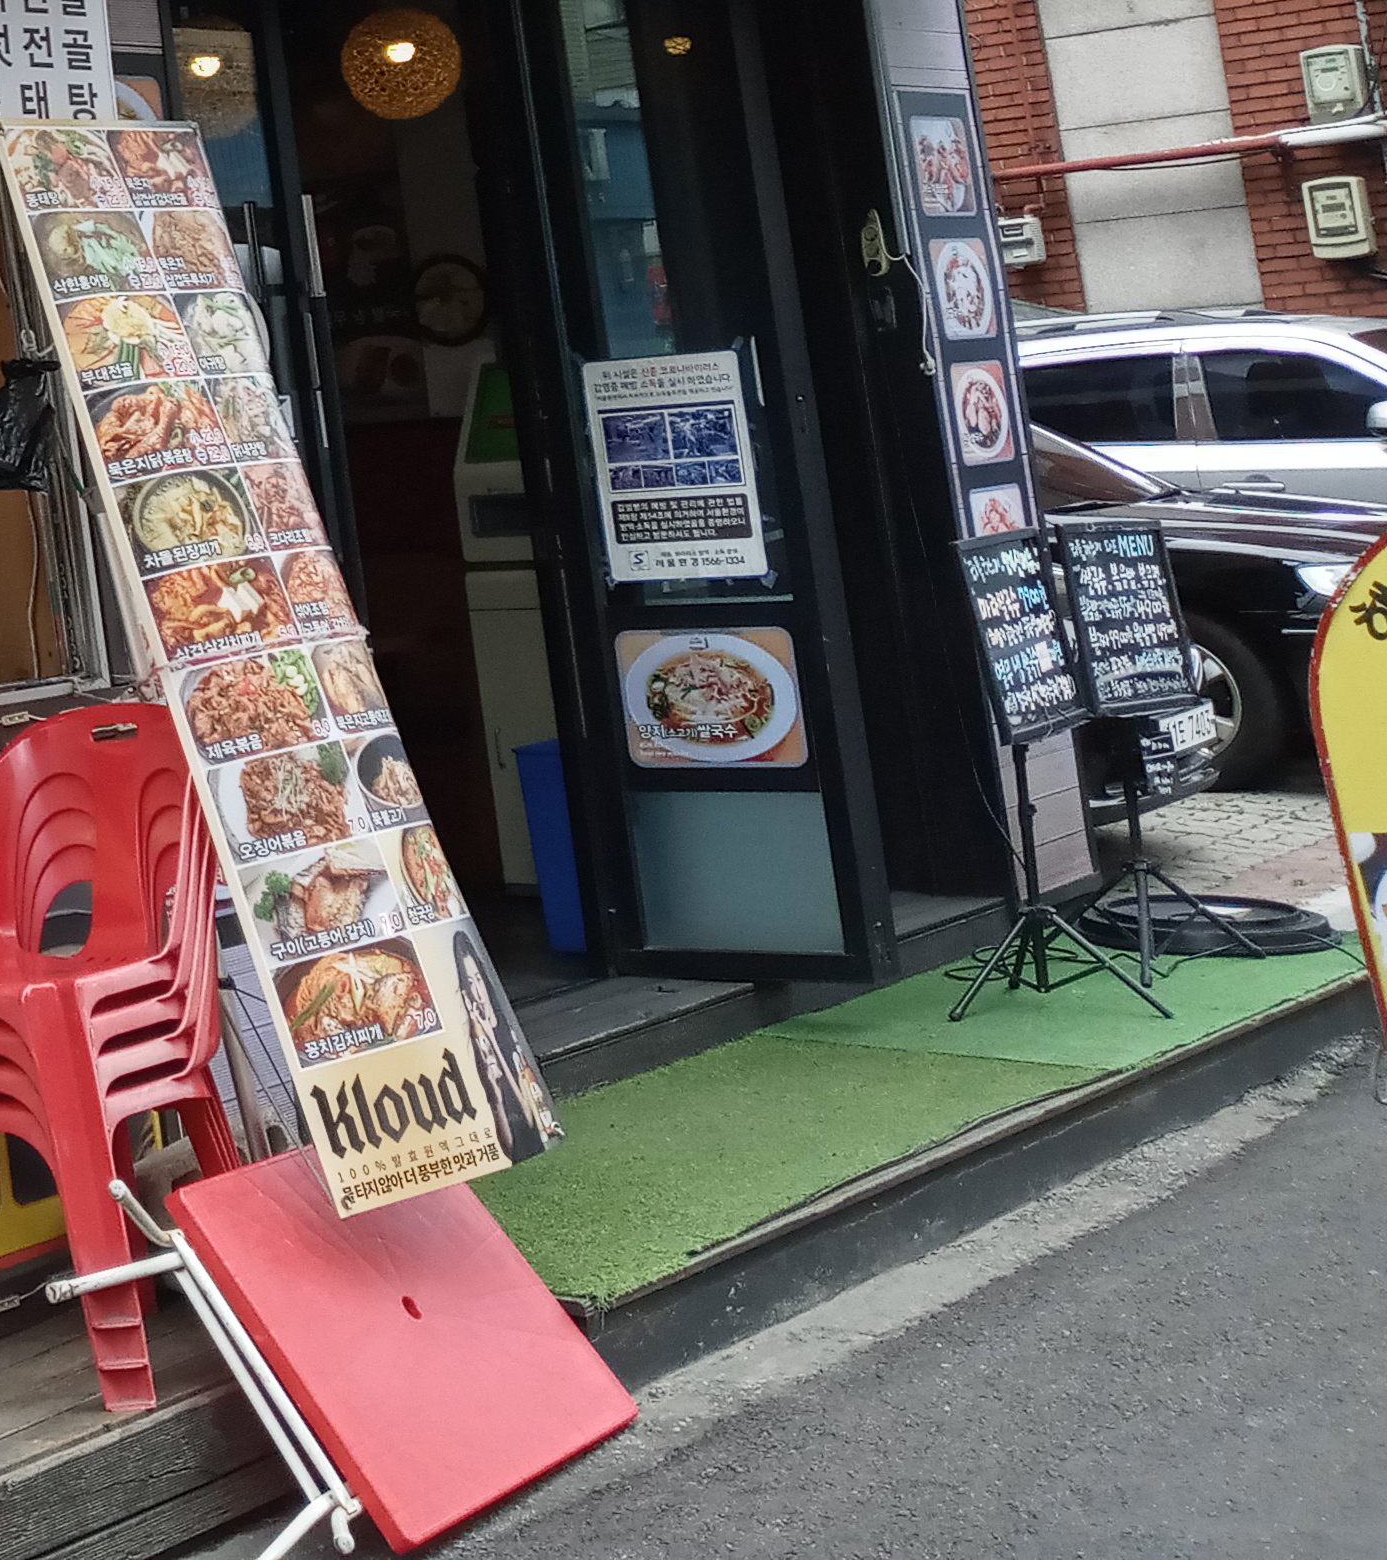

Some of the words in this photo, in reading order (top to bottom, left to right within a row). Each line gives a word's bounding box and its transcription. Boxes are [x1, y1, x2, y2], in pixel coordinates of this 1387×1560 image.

[25, 190, 61, 209] 동태탕
[81, 361, 135, 385] 부대전골
[1117, 534, 1155, 558] MENU
[205, 733, 264, 761] 제육볶음
[237, 829, 308, 861] 오징어볶음
[304, 1023, 384, 1060] 꽁치김치찌개
[309, 1046, 478, 1160] Kloud
